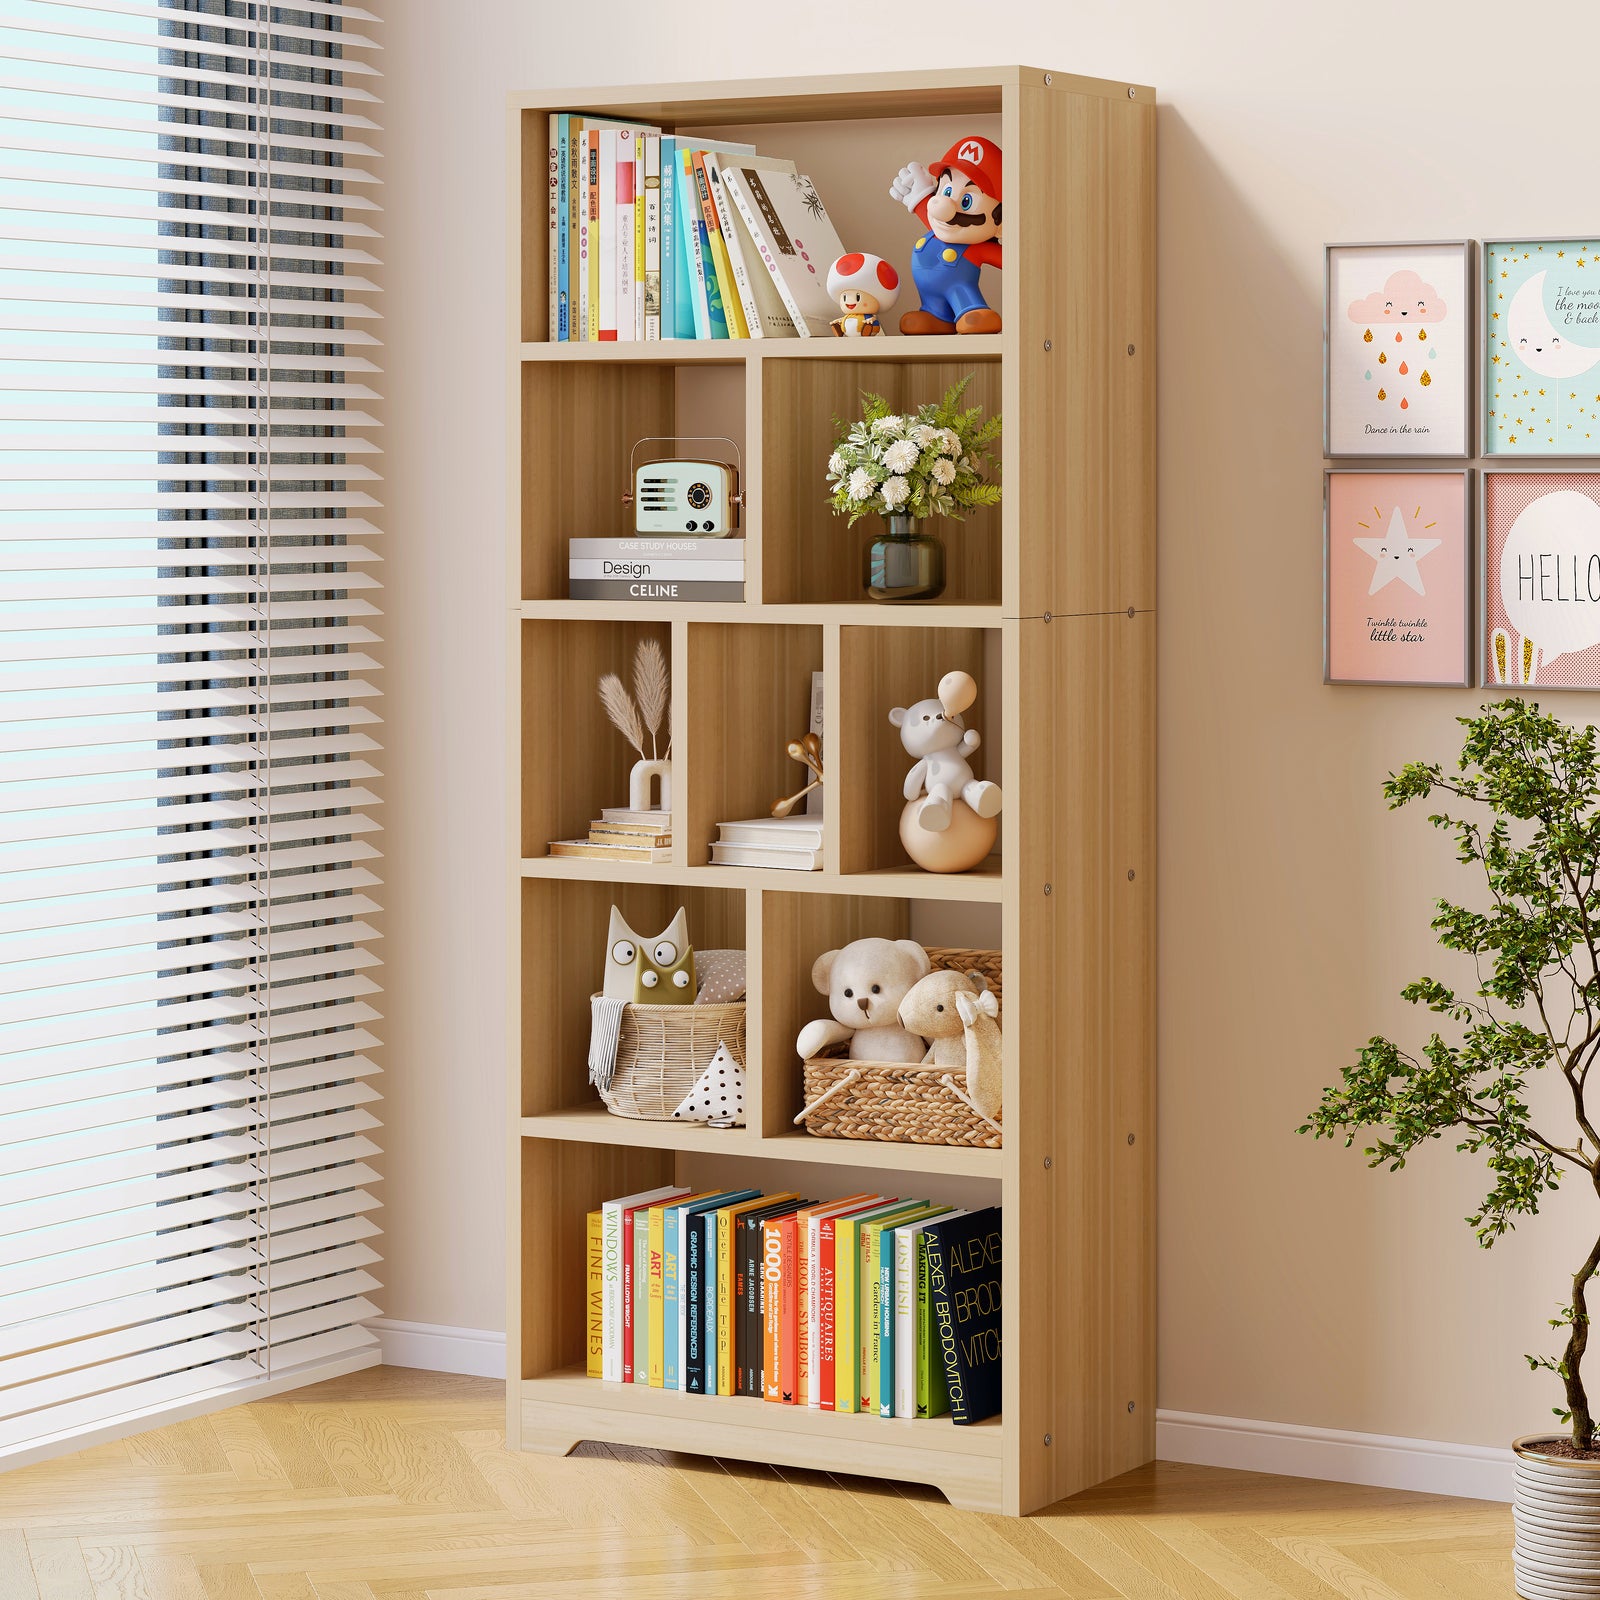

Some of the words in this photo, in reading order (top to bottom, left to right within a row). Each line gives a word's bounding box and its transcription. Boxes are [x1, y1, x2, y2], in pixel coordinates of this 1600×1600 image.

[960, 144, 979, 162] M
[1555, 297, 1574, 310] the
[1557, 287, 1563, 296] I
[1565, 287, 1580, 296] love
[1582, 289, 1595, 298] you
[1564, 312, 1573, 324] &
[1576, 312, 1598, 324] back
[1365, 424, 1388, 434] Dance
[1400, 424, 1412, 433] the
[619, 542, 638, 550] CASE
[640, 542, 665, 550] STUDY
[667, 542, 696, 551] HOUSES
[603, 561, 650, 578] Design
[1519, 554, 1600, 602] HELLO
[630, 584, 678, 596] CELINE
[1367, 618, 1397, 627] Twinkle
[1399, 618, 1428, 627] twinkle
[1370, 628, 1397, 641] little
[1401, 631, 1424, 642] star
[591, 1237, 602, 1280] FINE
[606, 1210, 617, 1281] WINDOWS
[766, 1229, 781, 1282] 1000
[898, 1235, 909, 1276] LOST
[651, 1250, 661, 1279] ART
[666, 1252, 676, 1280] ART
[800, 1258, 808, 1294] BOOK
[898, 1280, 909, 1315] FISH
[919, 1292, 926, 1304] IT
[591, 1291, 602, 1355] WINES
[824, 1268, 833, 1361] ANTIQUAIRES
[925, 1232, 947, 1296] ALEXEY
[936, 1302, 965, 1411] BRODOVITCH
[800, 1311, 808, 1378] SYMBOLS
